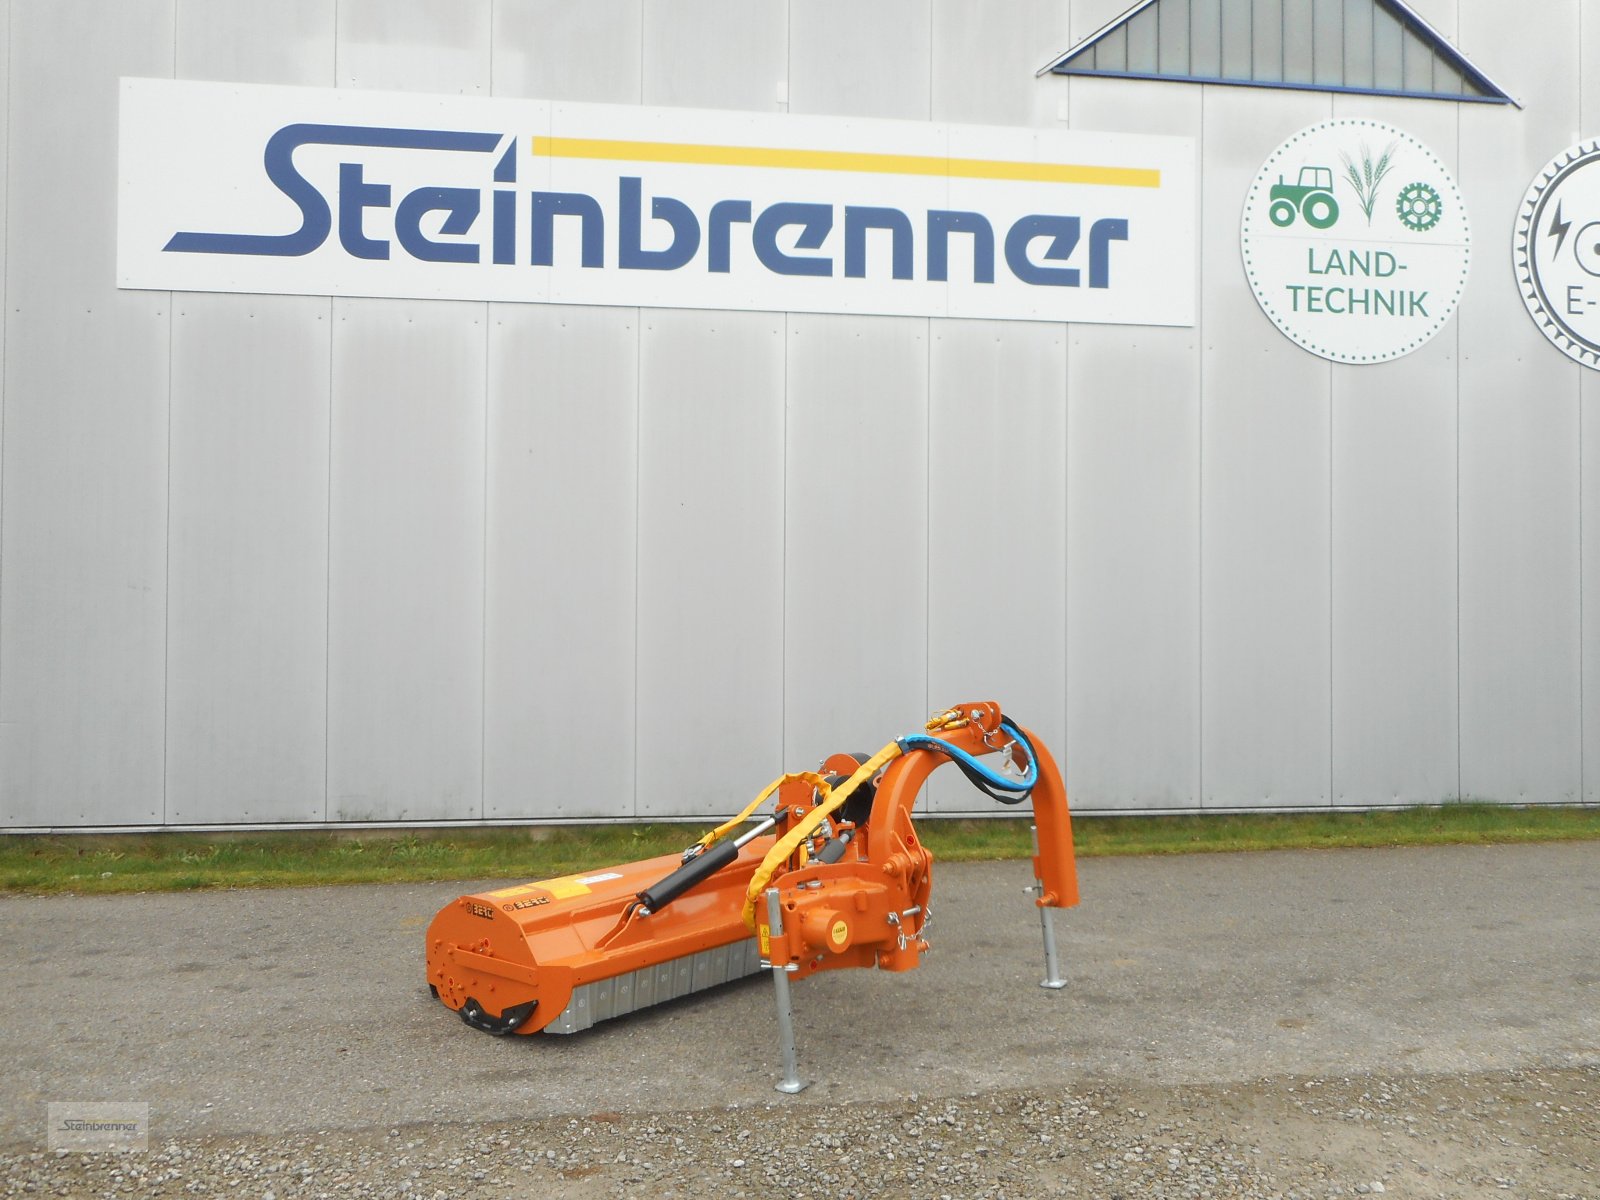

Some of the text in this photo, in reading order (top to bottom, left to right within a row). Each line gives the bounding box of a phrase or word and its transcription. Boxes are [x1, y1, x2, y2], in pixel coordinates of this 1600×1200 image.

[161, 122, 1128, 289] Steinbrenner
[1308, 248, 1408, 278] LAND-
[1285, 285, 1430, 318] TECHNIK
